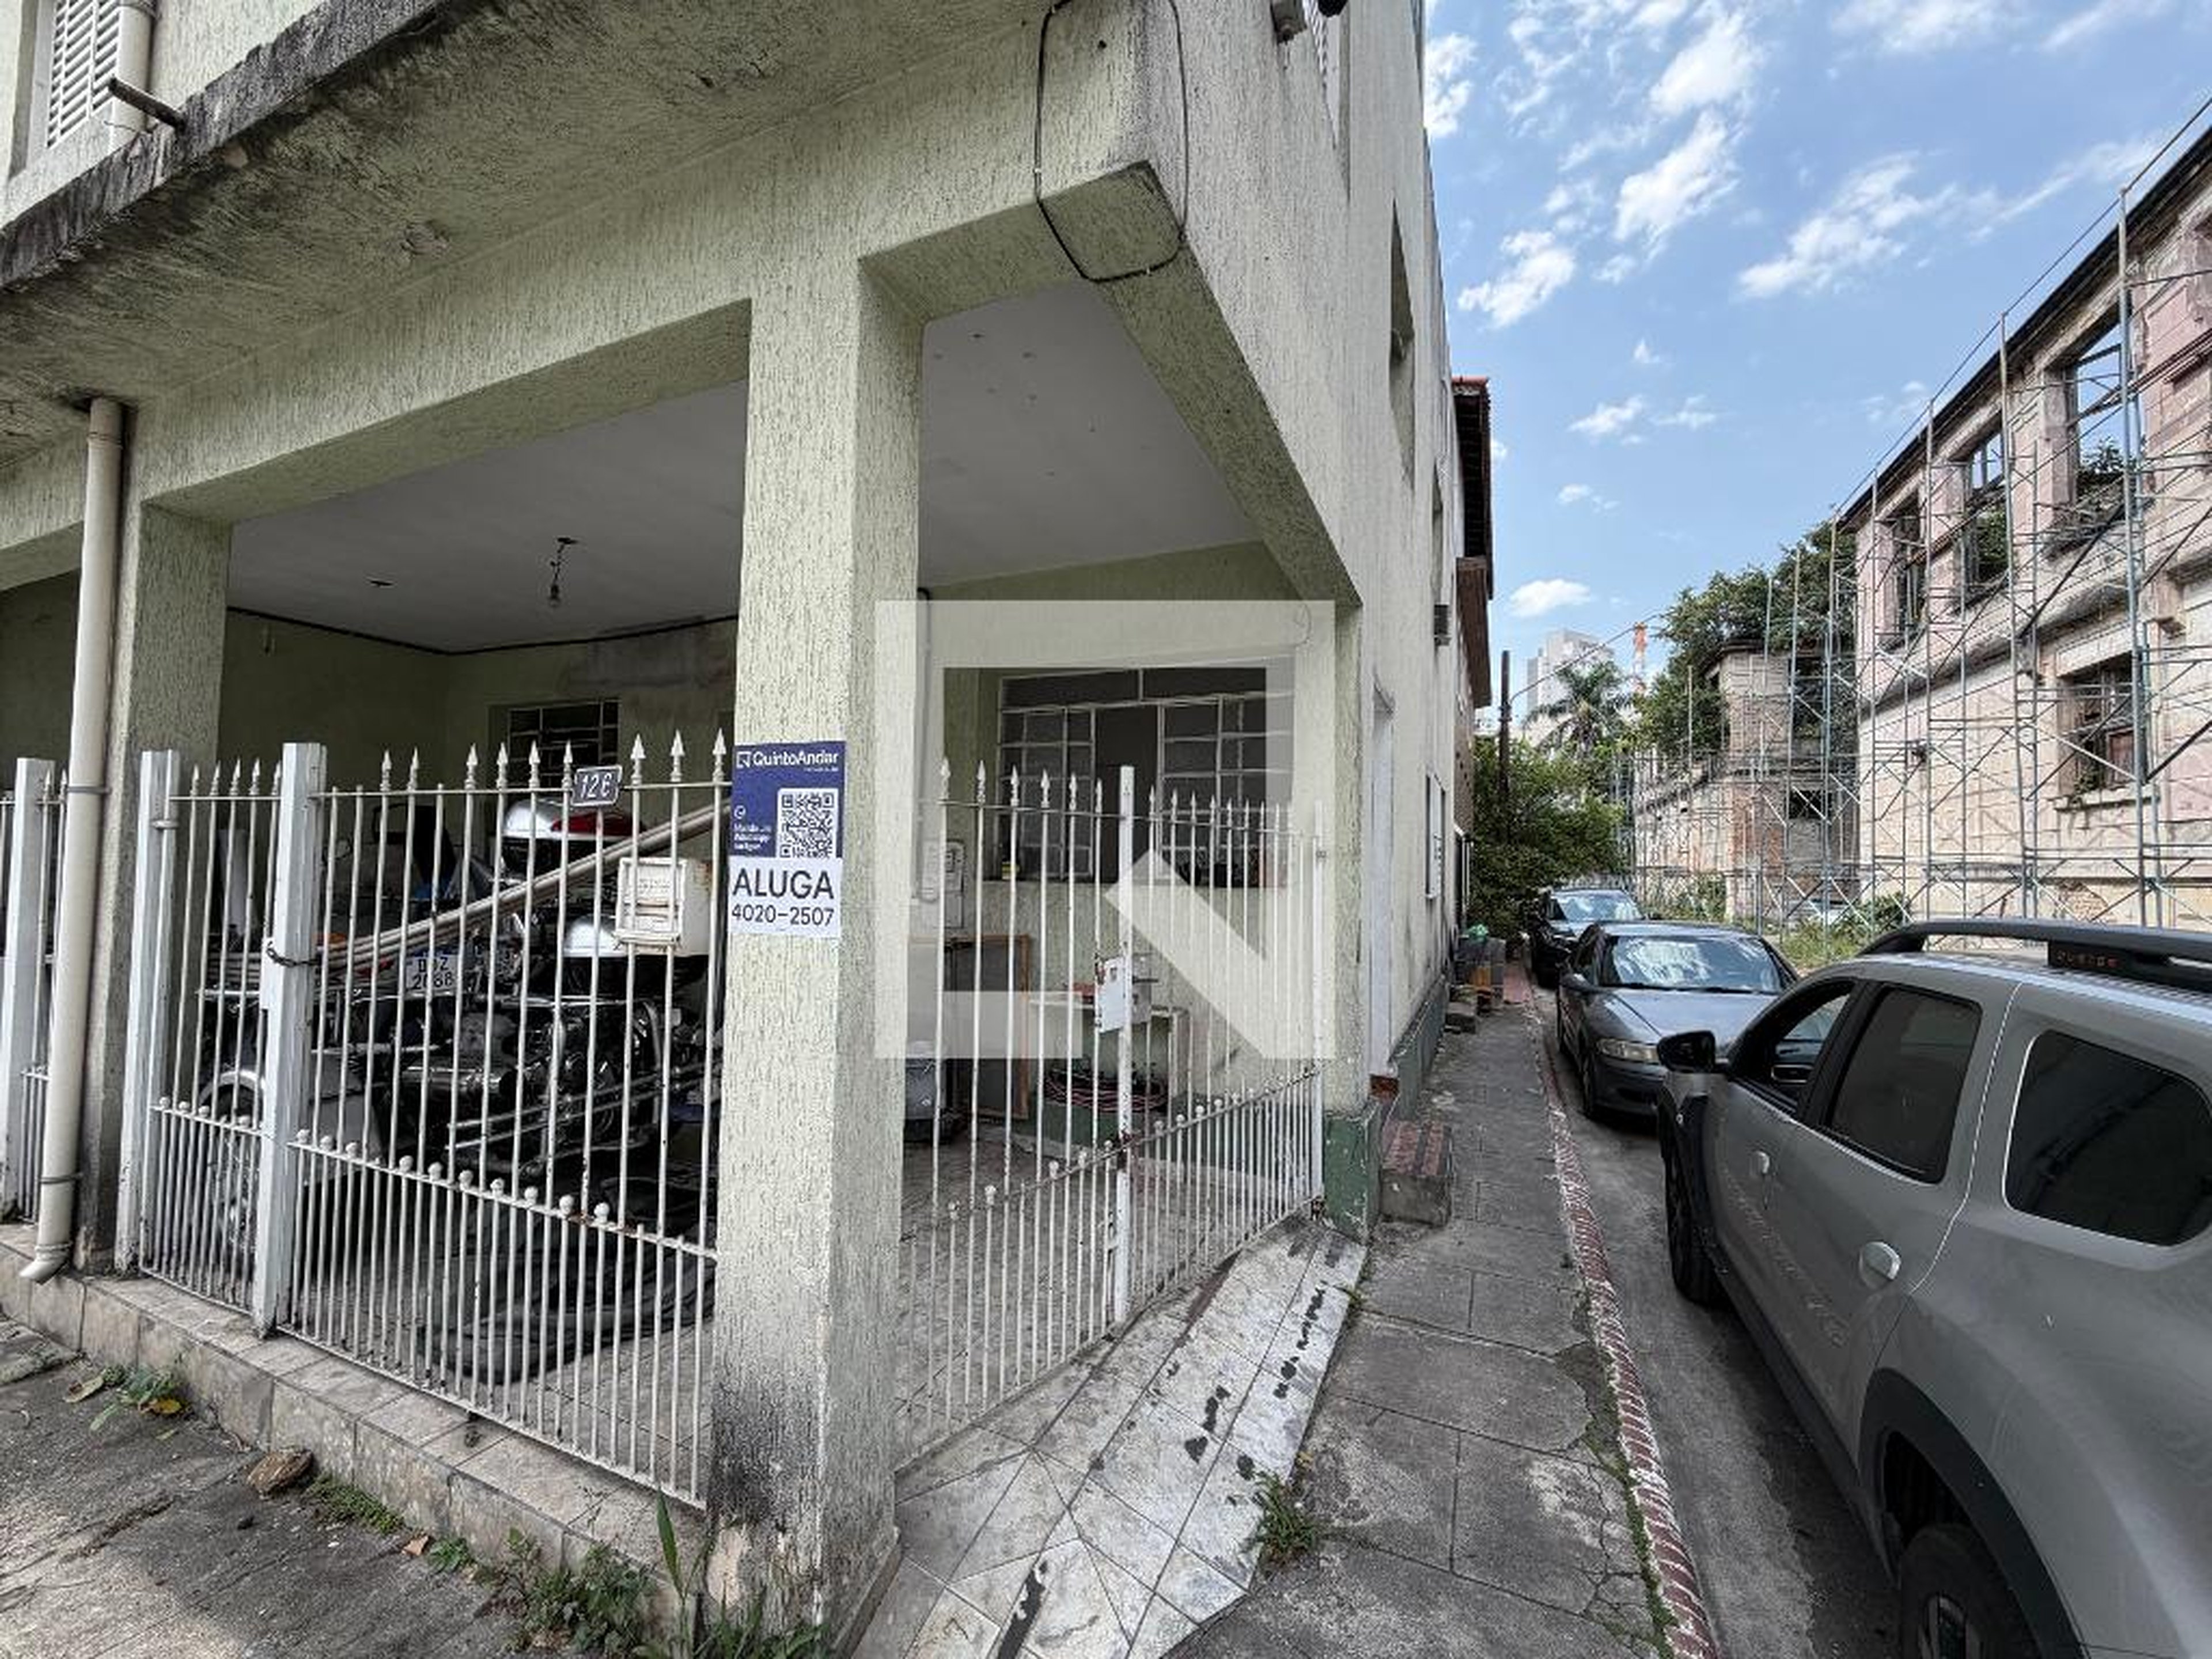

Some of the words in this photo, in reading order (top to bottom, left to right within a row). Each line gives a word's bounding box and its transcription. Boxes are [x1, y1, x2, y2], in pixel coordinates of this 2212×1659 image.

[752, 749, 839, 766] QuintoAndar
[732, 868, 835, 900] ALUGA
[732, 903, 835, 927] 4020-2507
